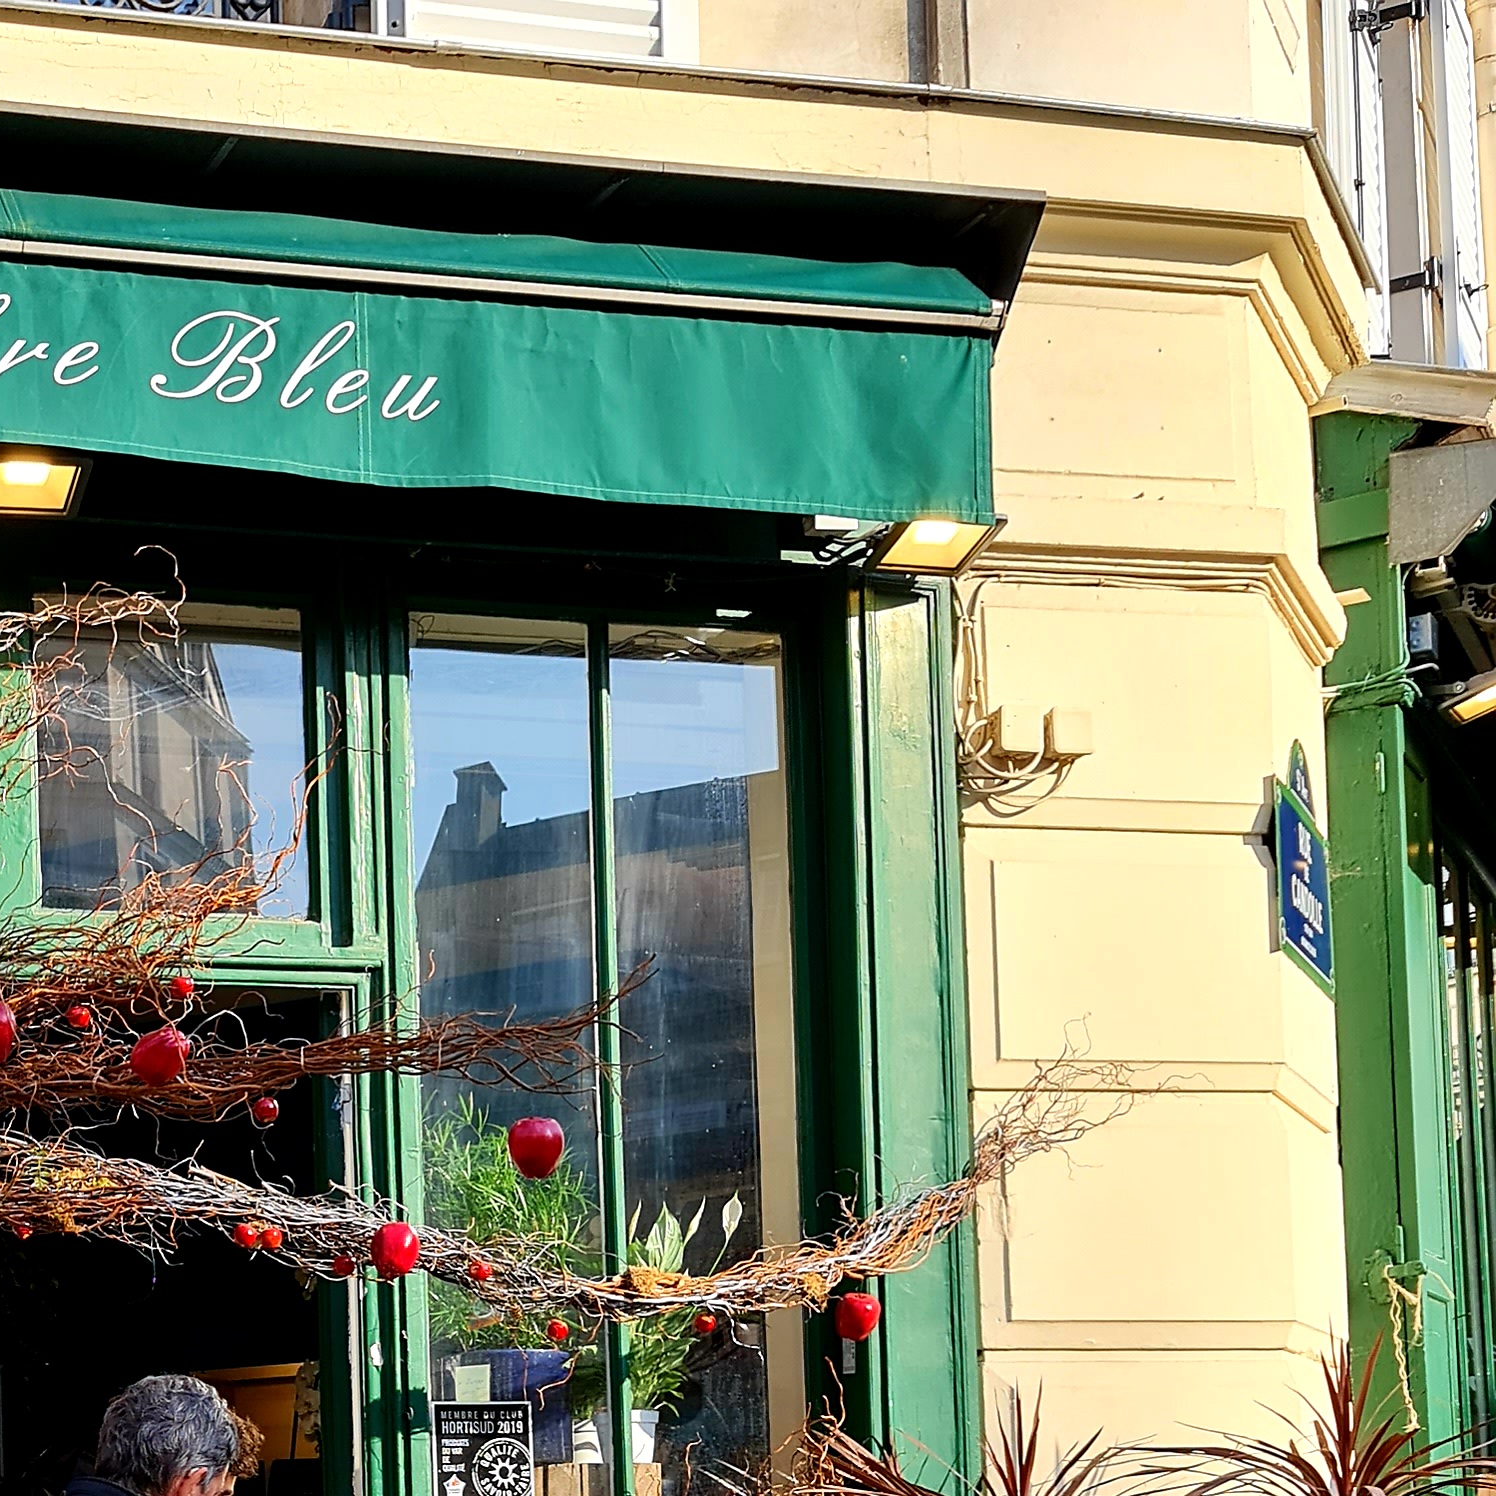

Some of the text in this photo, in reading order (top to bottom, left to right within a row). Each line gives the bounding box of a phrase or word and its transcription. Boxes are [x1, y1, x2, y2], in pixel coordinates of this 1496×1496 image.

[149, 309, 442, 423] Bleu
[440, 1410, 523, 1419] MEMBRE DU CLUB
[441, 1420, 523, 1434] HORTISUD 2019
